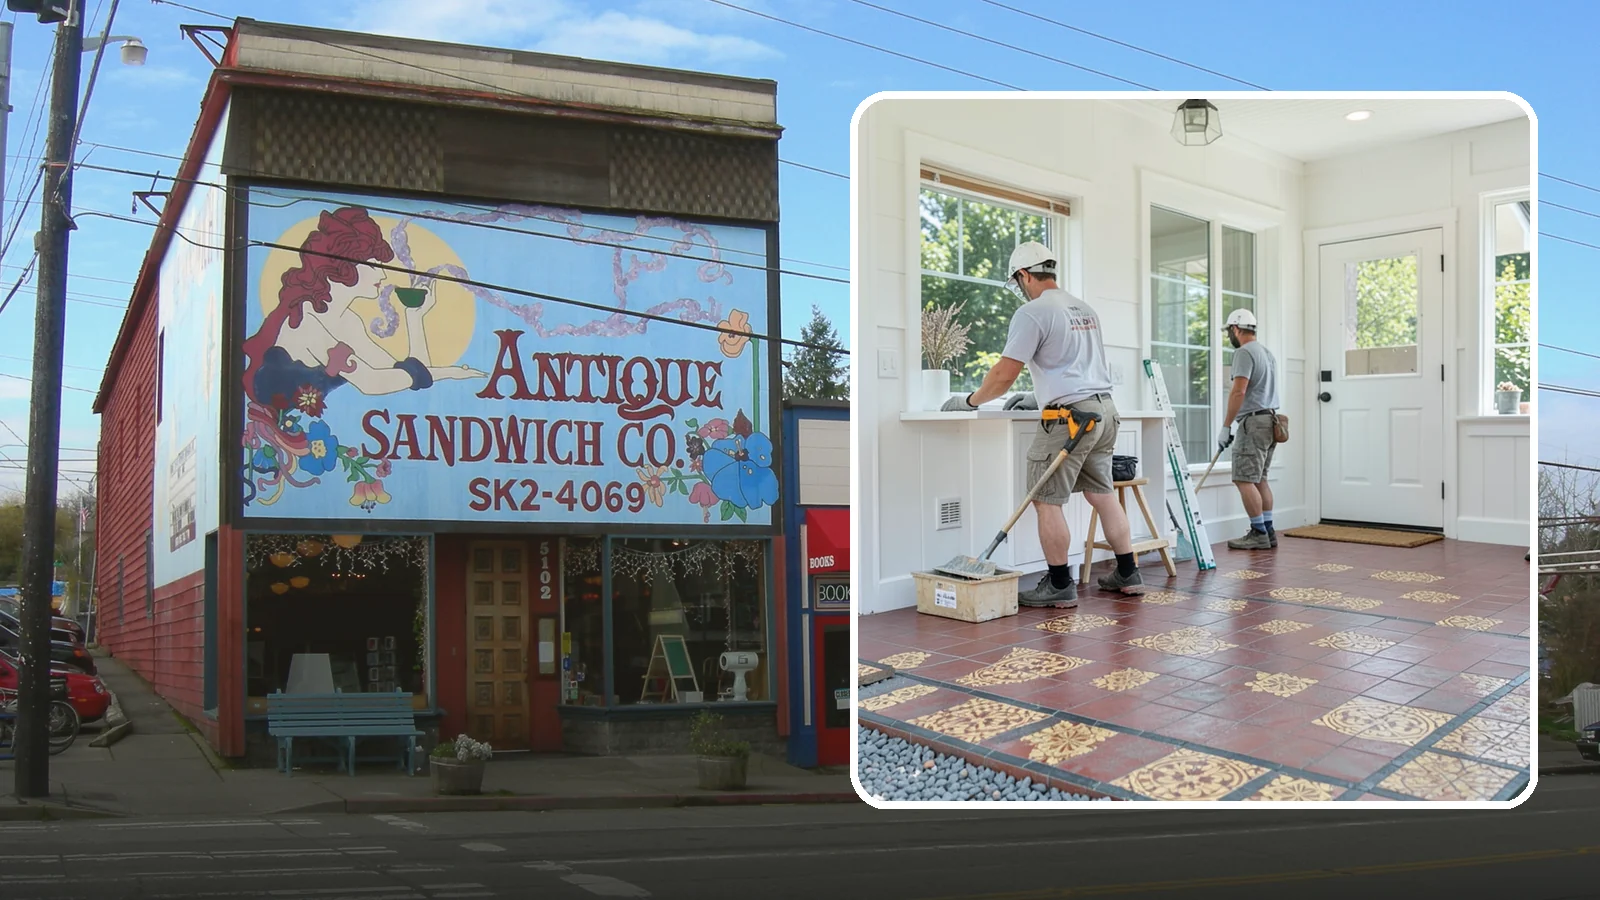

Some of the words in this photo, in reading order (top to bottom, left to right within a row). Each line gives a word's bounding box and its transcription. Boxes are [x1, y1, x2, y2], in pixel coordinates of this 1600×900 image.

[476, 329, 723, 420] ANTIQUE
[361, 409, 604, 467] SANDWICH
[617, 423, 685, 468] CO.
[469, 477, 646, 512] SK2-4069
[540, 542, 552, 600] 5102
[809, 555, 835, 569] BOOKS
